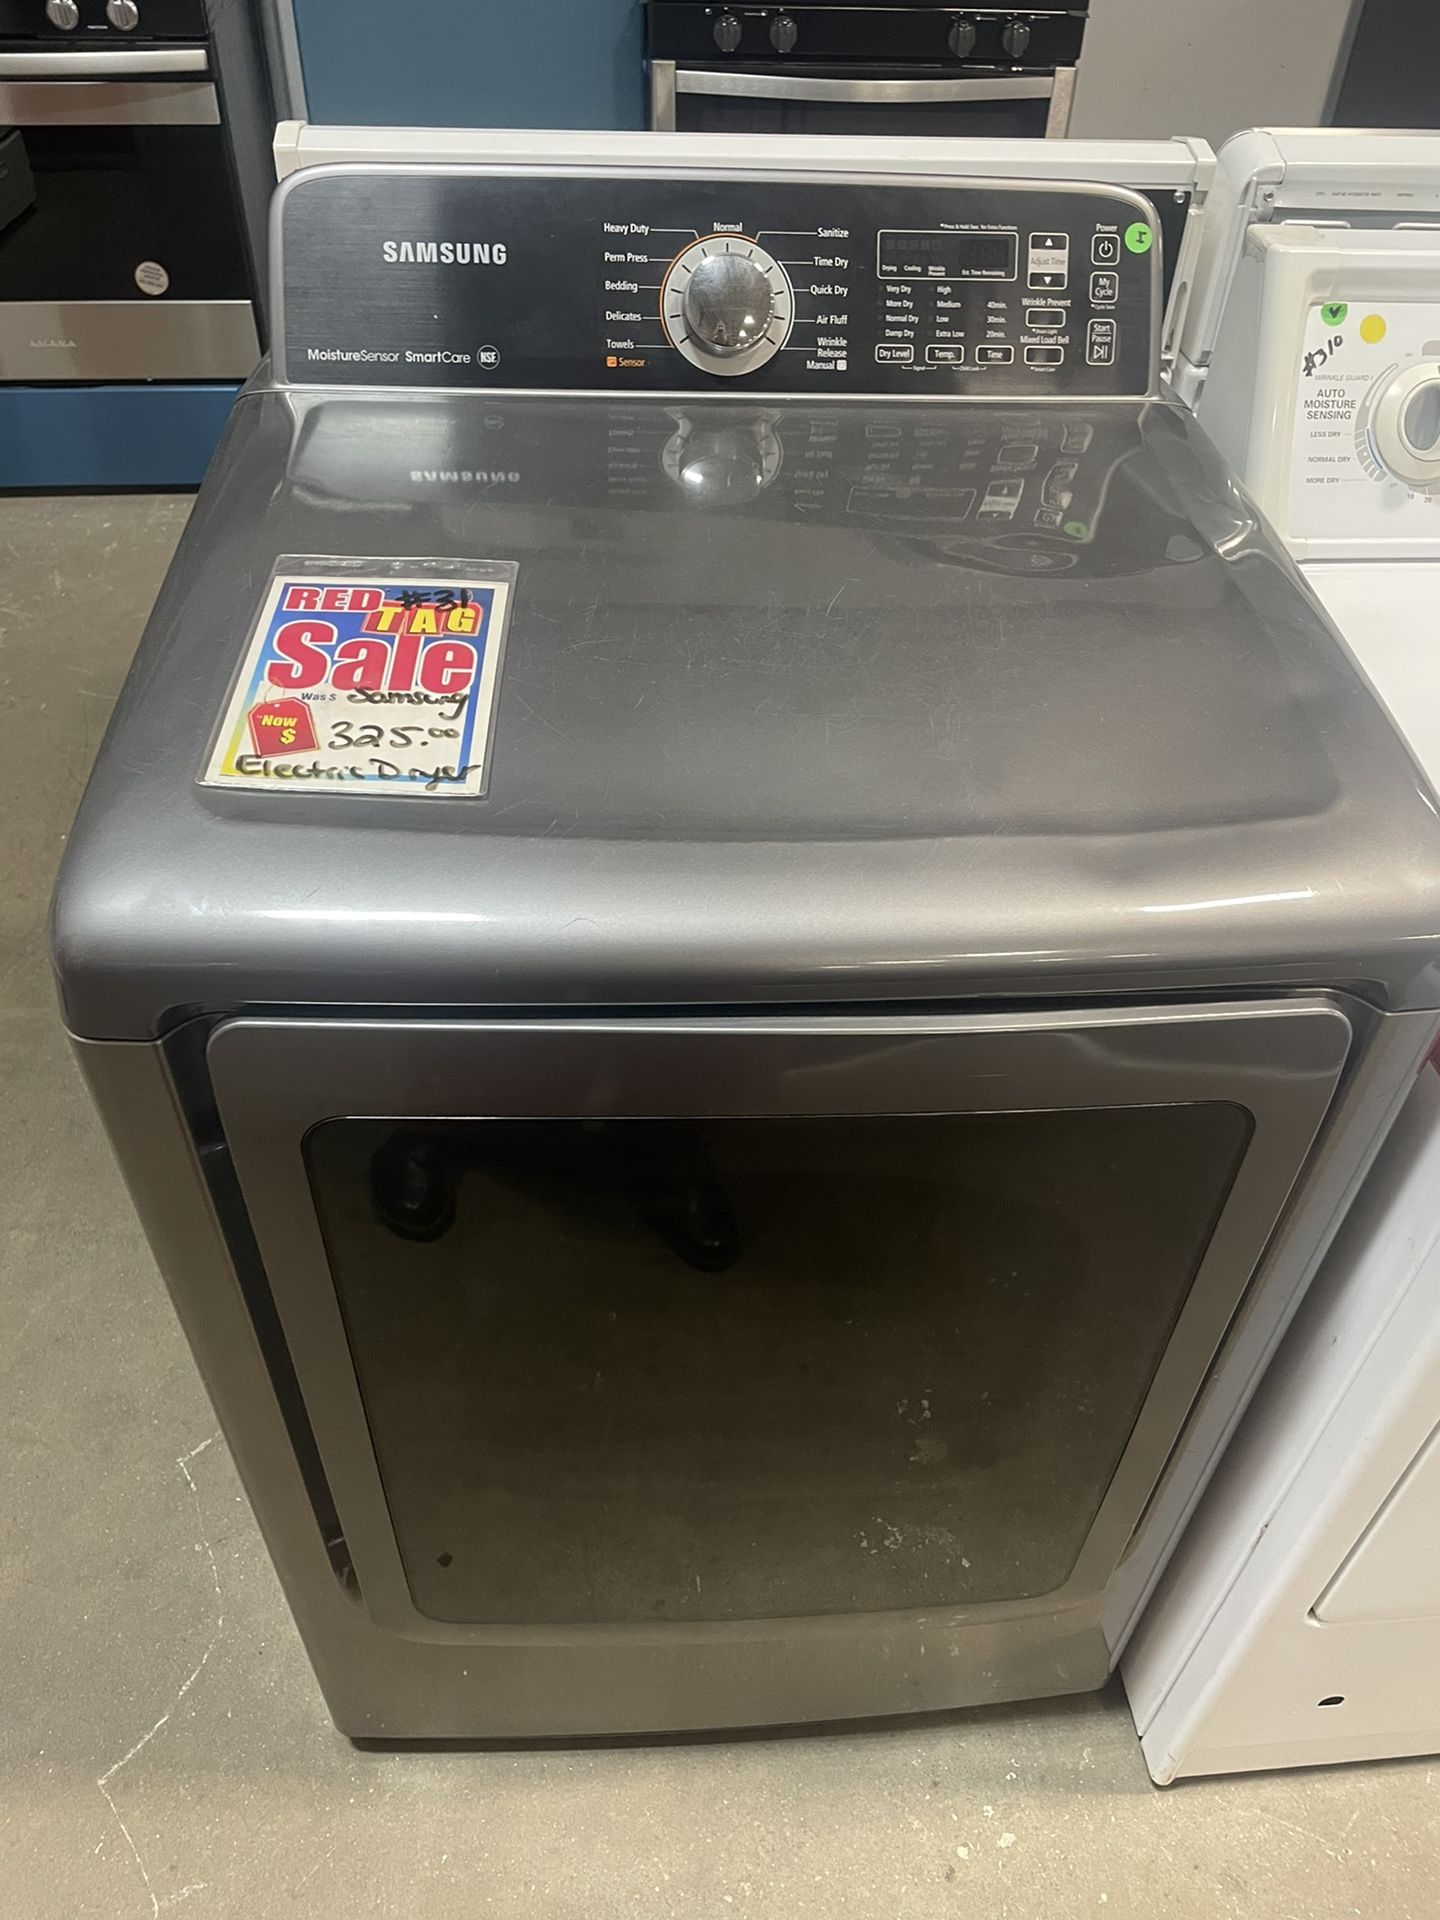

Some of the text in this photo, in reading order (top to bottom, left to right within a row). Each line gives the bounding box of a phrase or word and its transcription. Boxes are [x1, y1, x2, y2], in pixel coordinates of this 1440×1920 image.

[604, 223, 649, 236] Heavy Duty
[713, 222, 743, 233] Normal
[817, 227, 849, 238] Sanitize
[1096, 223, 1118, 232] Power
[383, 241, 507, 265] SAMSUNG
[604, 252, 649, 263] Perm Press
[814, 257, 849, 269] Time Dry
[1031, 257, 1066, 267] Adjust Time
[605, 281, 638, 293] Bedding
[1099, 278, 1111, 289] My
[810, 284, 849, 297] Quick Dry
[886, 285, 912, 294] Very Dry
[936, 286, 952, 295] High
[1094, 287, 1114, 298] Cycle
[886, 300, 914, 309] More Dry
[1021, 297, 1072, 307] Wrinkle Prevent
[606, 311, 642, 321] Delicates
[816, 315, 848, 325] Air Fluff
[908, 315, 919, 324] Dry
[1093, 323, 1110, 332] Start
[885, 329, 915, 338] Damp Dry
[935, 330, 965, 338] Extra Low
[606, 339, 634, 349] Towels
[817, 337, 848, 346] Wrinkle
[1020, 336, 1070, 344] Mixed Load Bell
[1091, 335, 1112, 343] Pause
[307, 349, 471, 364] MoistureSensor SmartCare
[817, 348, 848, 358] Release
[879, 350, 910, 359] Dry Level
[934, 350, 956, 359] Temp.
[987, 350, 1003, 358] Time
[618, 357, 645, 367] Sensor
[806, 360, 835, 370] Manual
[1317, 389, 1345, 398] AUTO
[1304, 400, 1356, 409] MOISTURE
[1306, 410, 1351, 420] SENSING
[283, 587, 385, 612] RED
[376, 605, 476, 634] TAG
[265, 619, 479, 694] Sale
[301, 692, 327, 701] Was
[347, 687, 470, 721] Samsung
[280, 728, 296, 745] $
[235, 754, 481, 791] Electric Dryer
